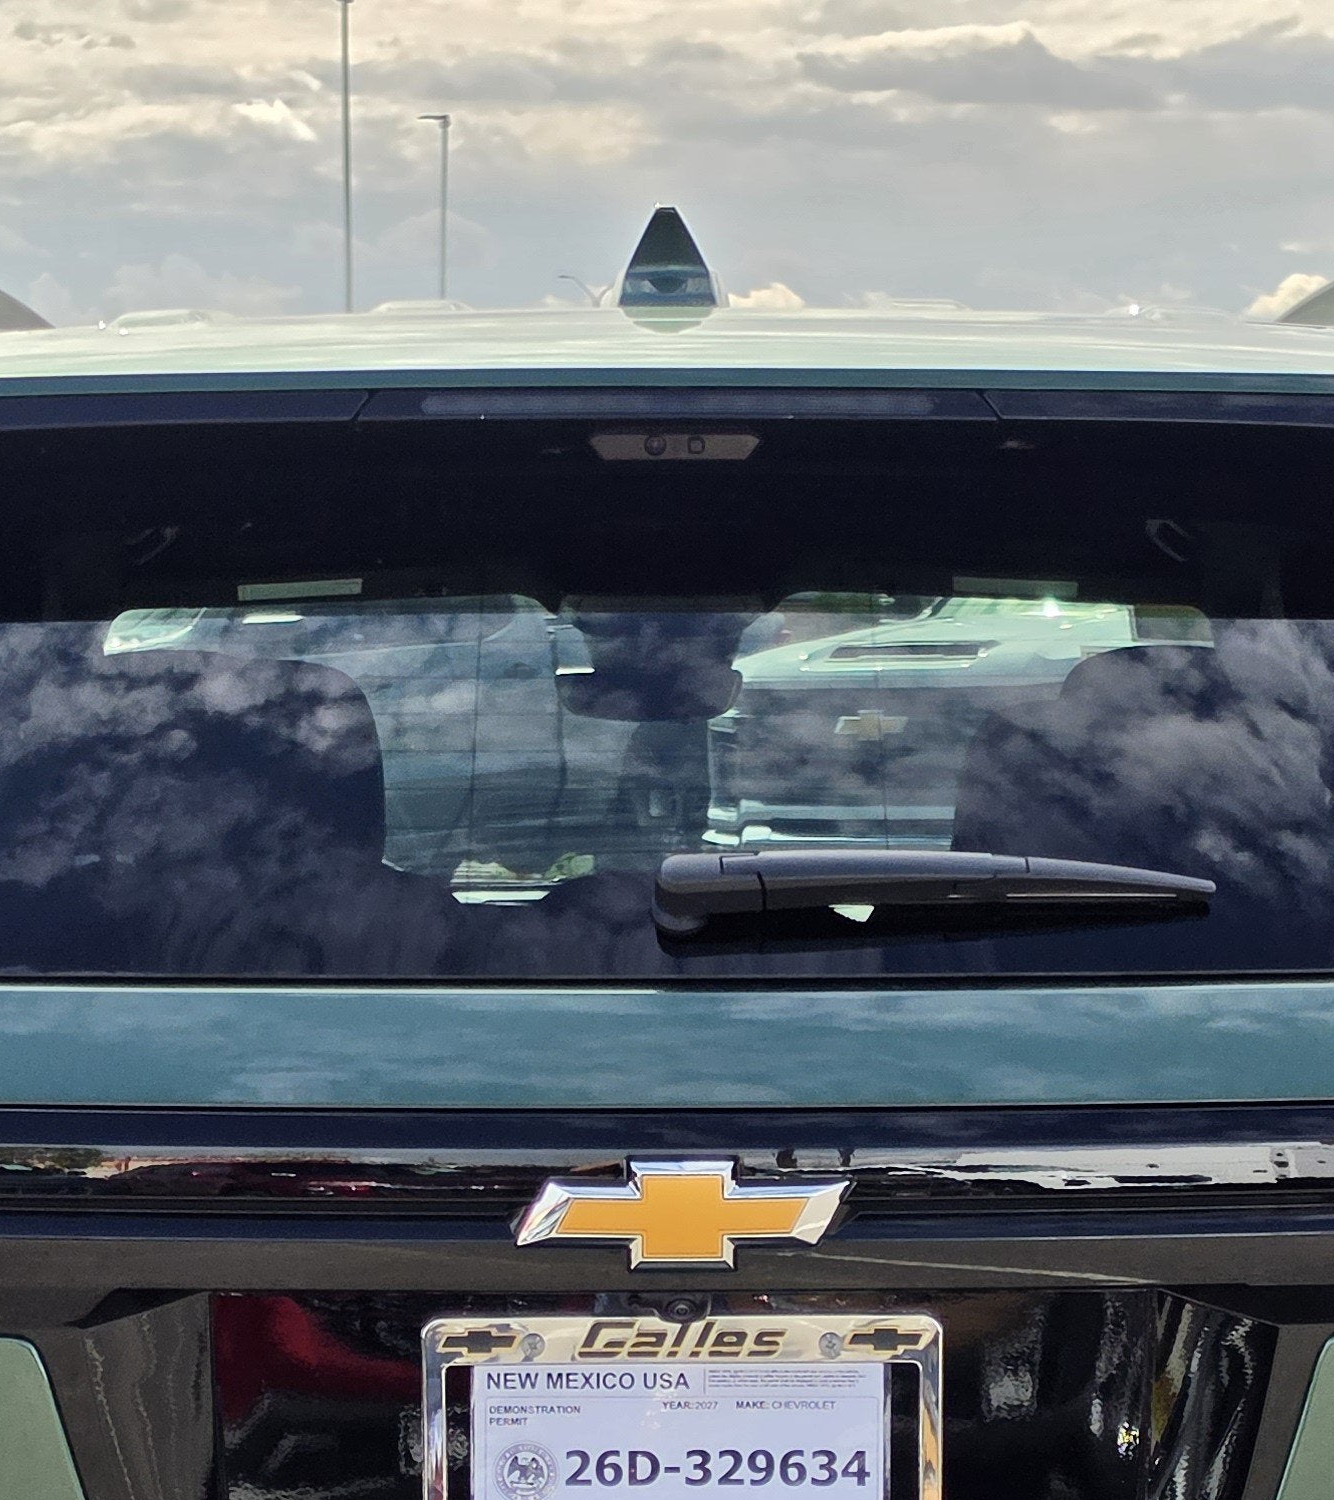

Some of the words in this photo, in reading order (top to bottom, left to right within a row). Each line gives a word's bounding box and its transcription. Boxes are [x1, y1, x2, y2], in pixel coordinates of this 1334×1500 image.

[577, 1320, 788, 1359] Galles
[486, 1372, 539, 1390] NEW
[546, 1372, 635, 1390] MEXICO
[643, 1372, 690, 1390] USA
[489, 1405, 581, 1415] DEMONSTRATION
[771, 1400, 836, 1410] CHEVROLET
[489, 1417, 528, 1426] PERMIT
[565, 1448, 871, 1487] 26D-329634
